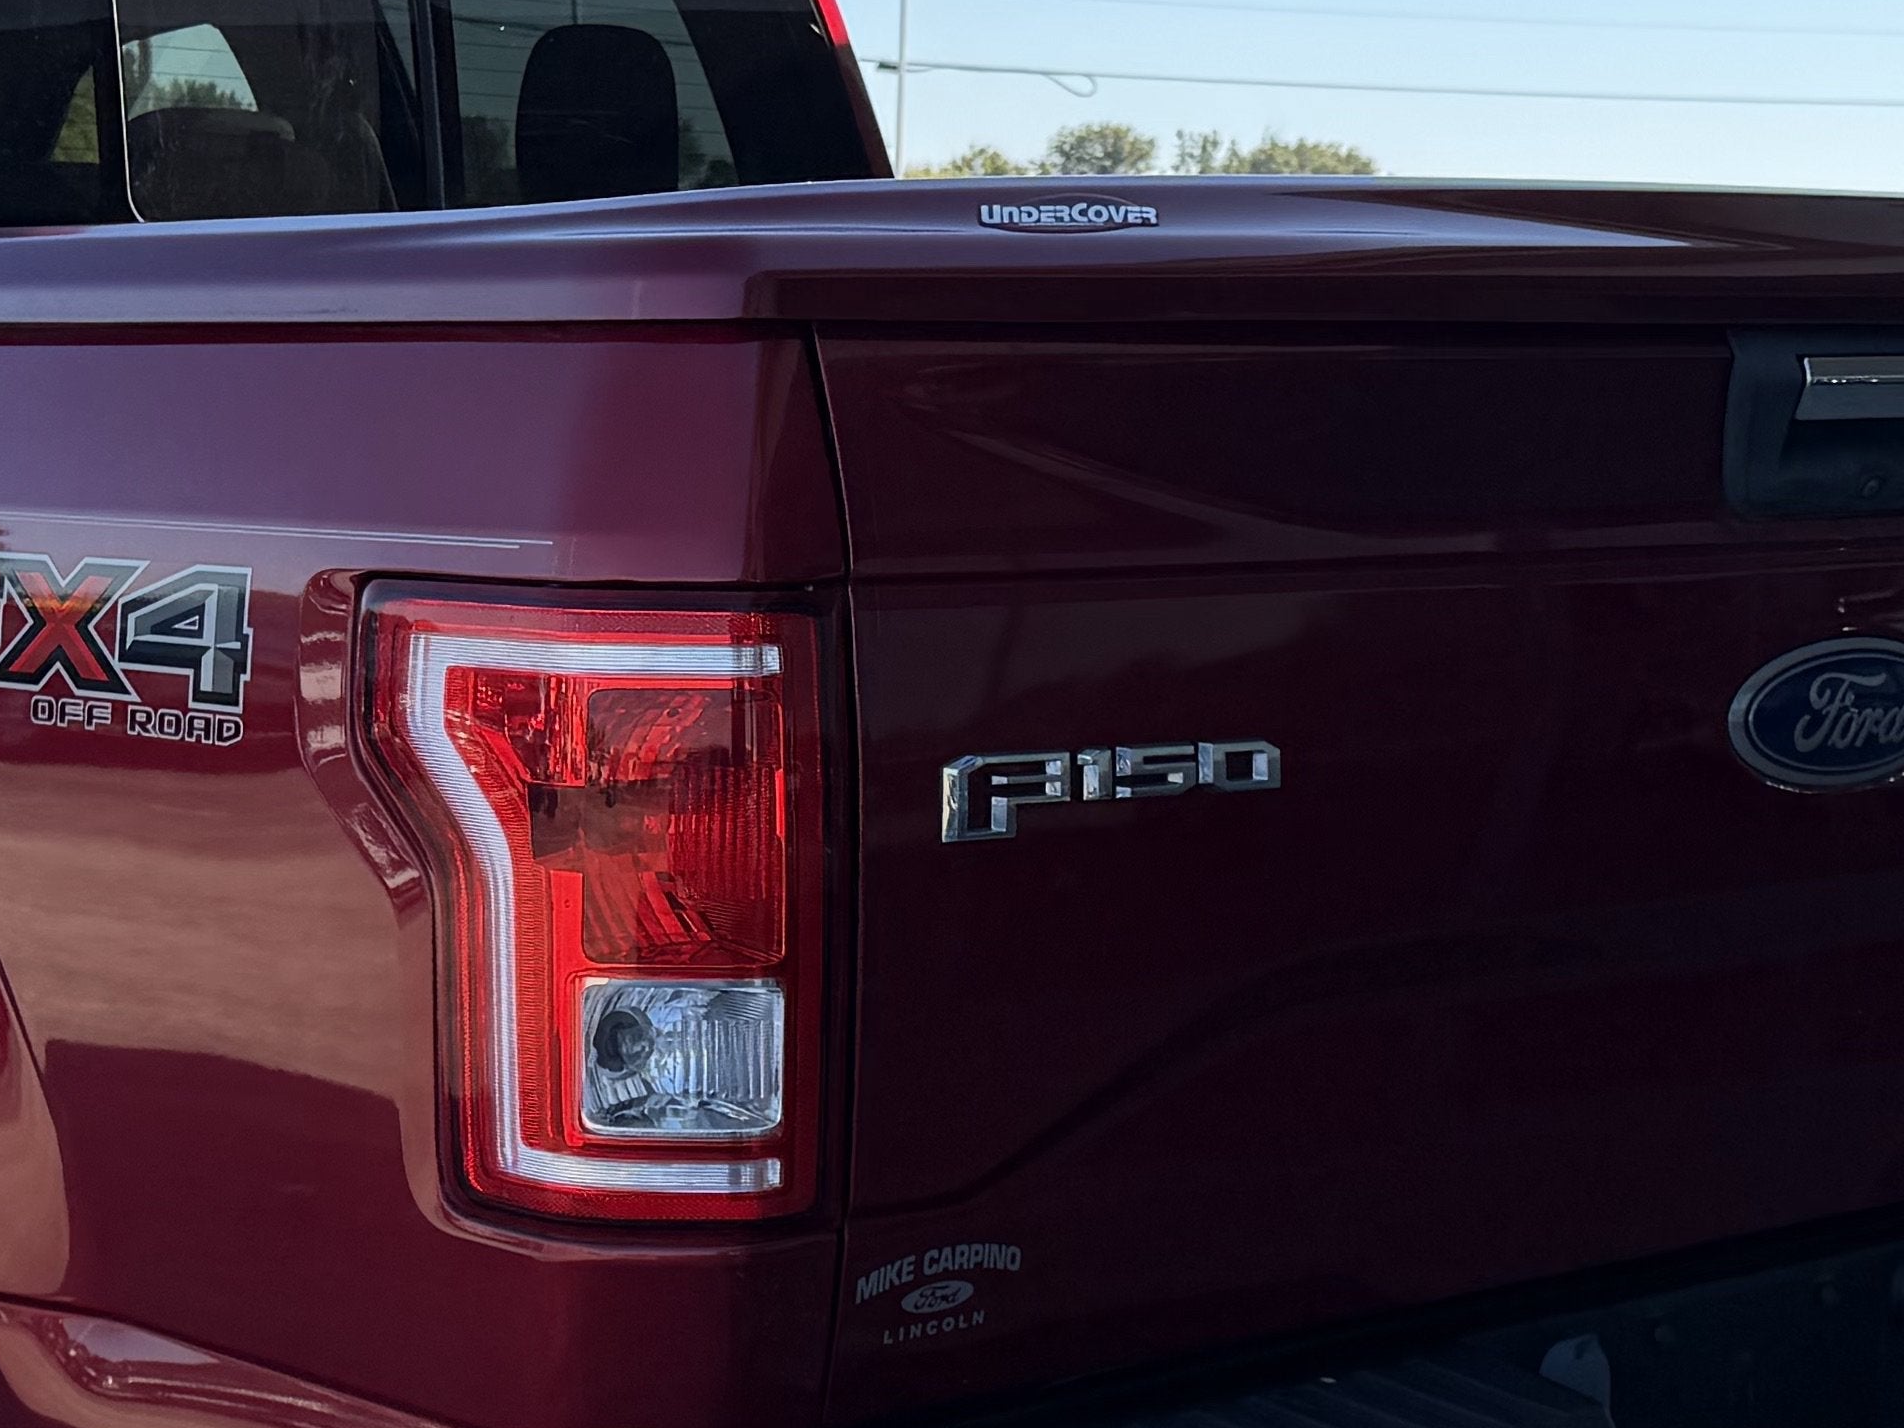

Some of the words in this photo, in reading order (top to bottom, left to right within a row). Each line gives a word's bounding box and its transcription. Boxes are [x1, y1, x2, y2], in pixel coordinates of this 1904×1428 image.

[31, 695, 112, 731] OFF
[127, 705, 244, 746] ROAD
[855, 1254, 915, 1304] MIKE
[923, 1243, 1022, 1275] CARPINO
[914, 1285, 961, 1310] Ford
[883, 1310, 985, 1345] LINCOLN
